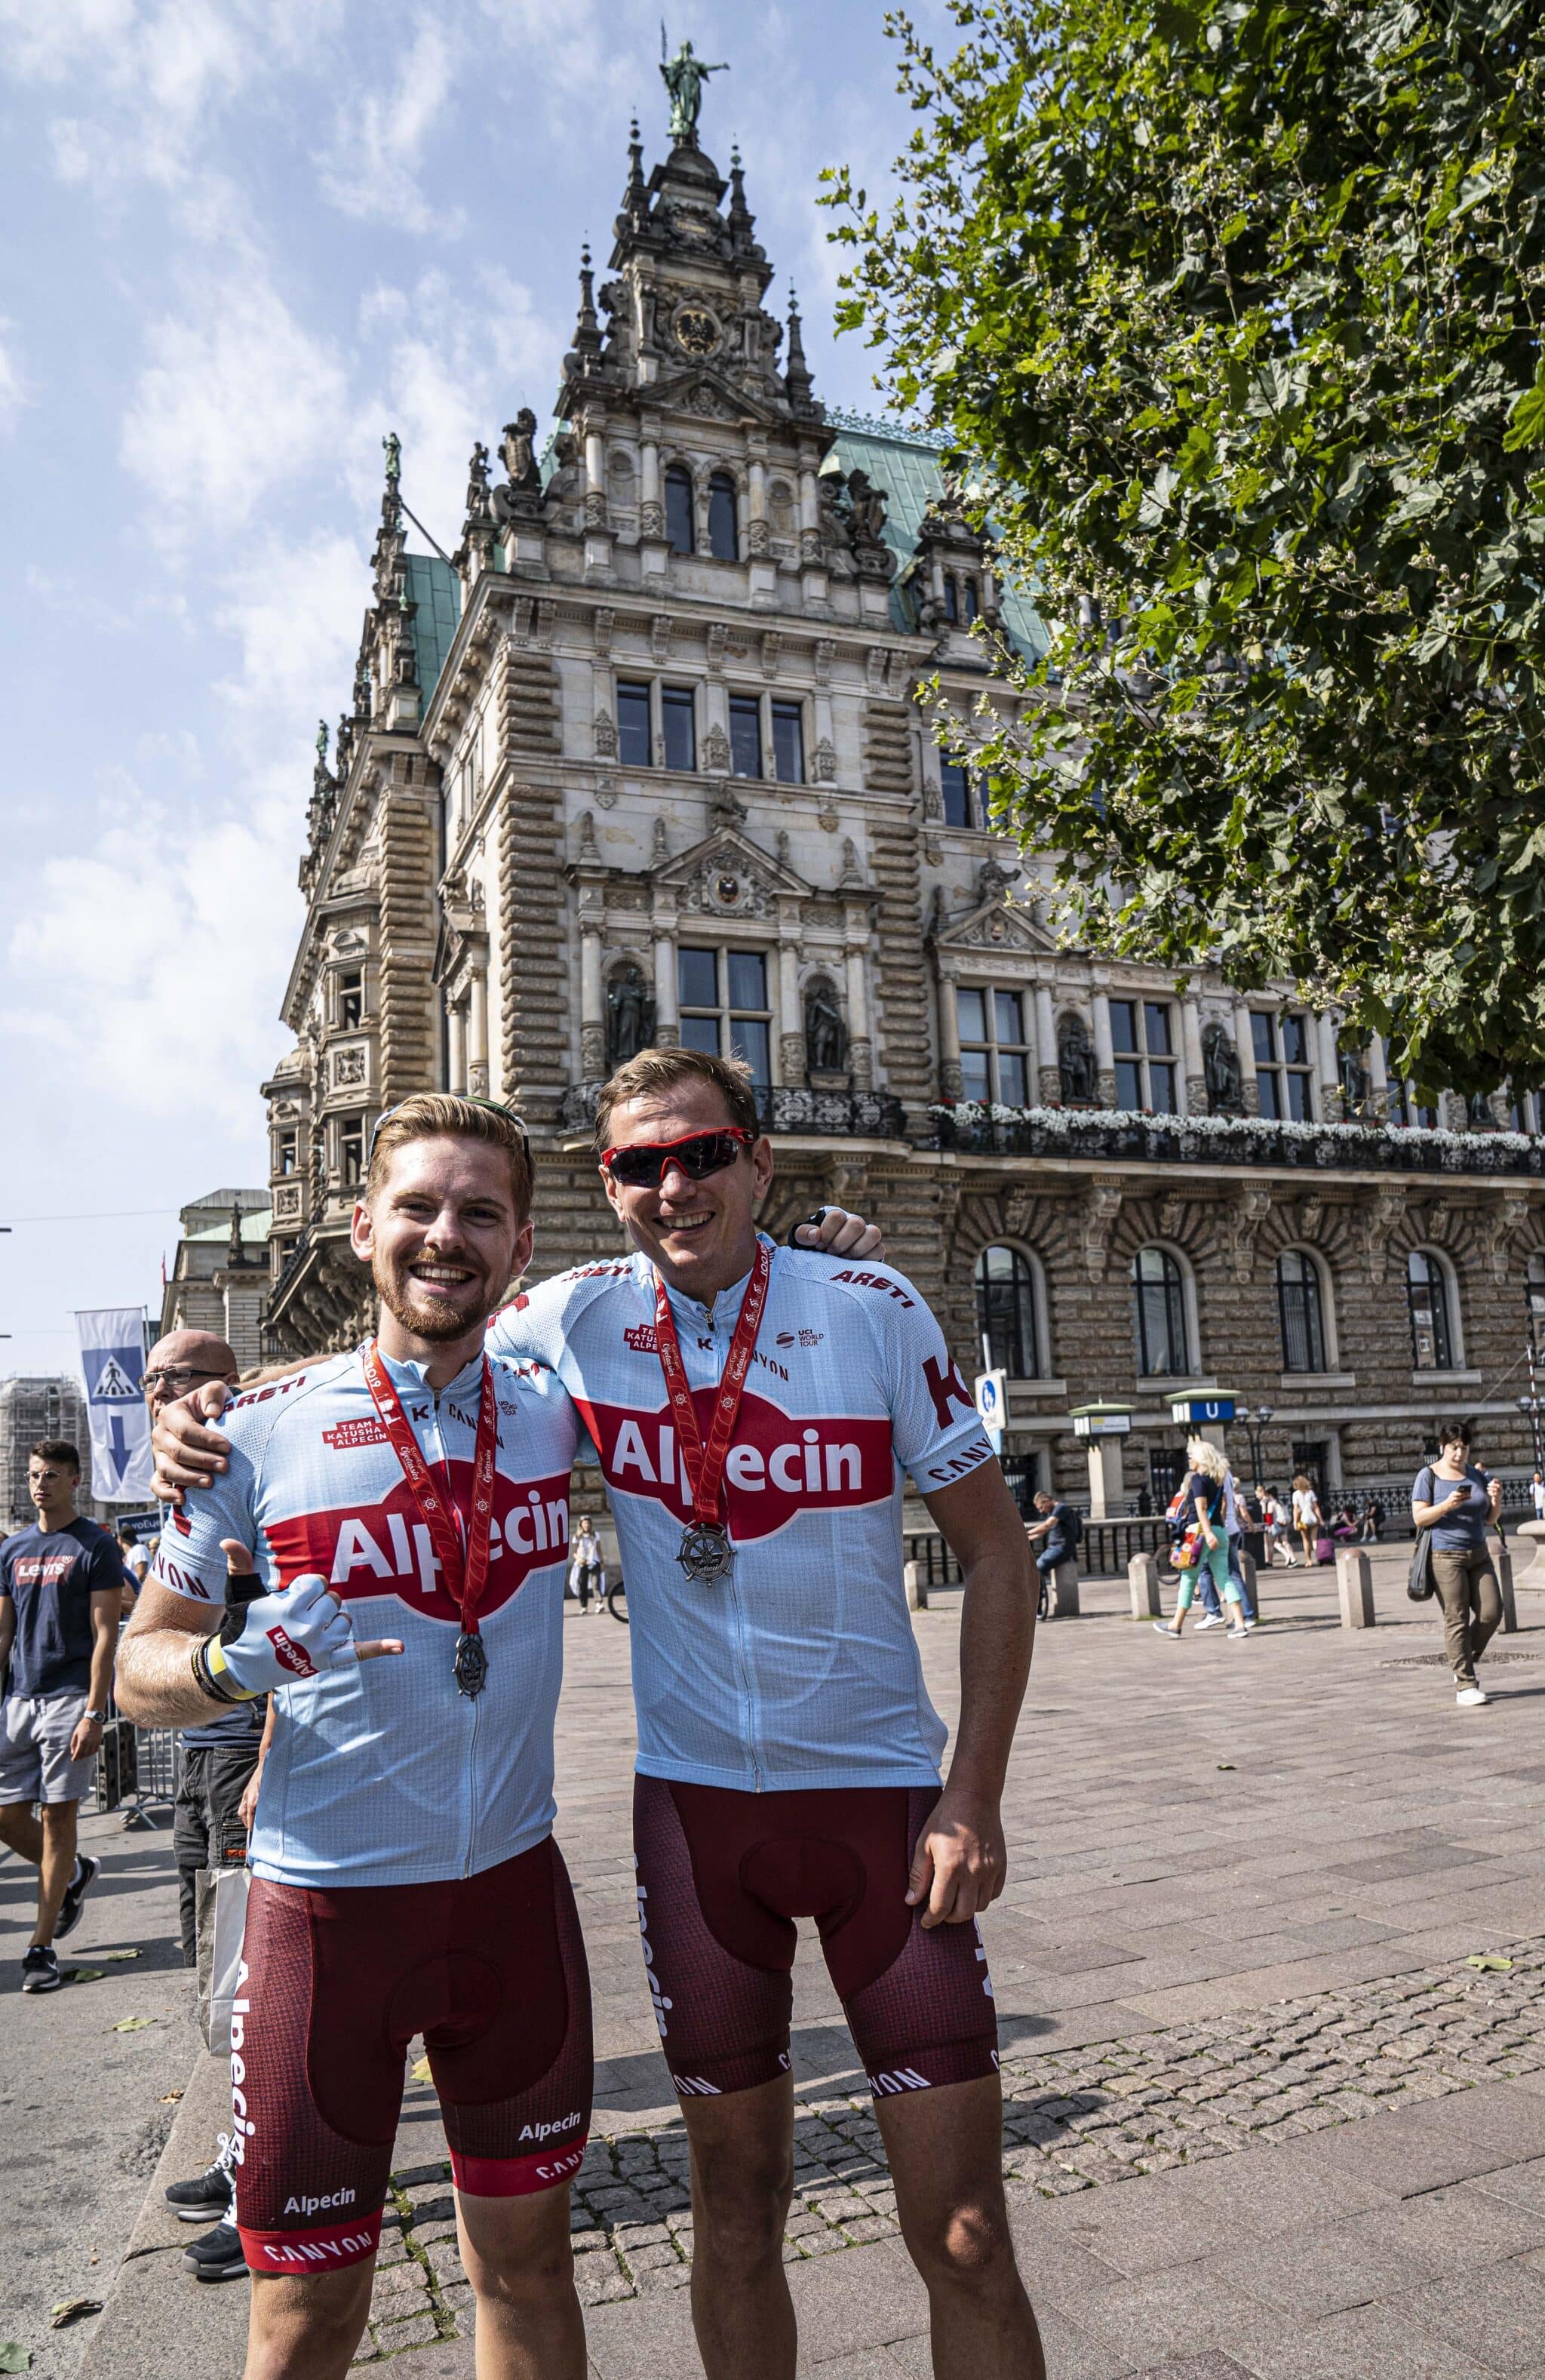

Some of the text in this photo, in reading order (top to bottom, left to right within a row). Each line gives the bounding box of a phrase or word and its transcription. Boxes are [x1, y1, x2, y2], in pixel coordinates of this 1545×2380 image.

[829, 1270, 916, 1309] ARETI
[634, 1341, 658, 1351] ALPE
[751, 1350, 790, 1382] NYON
[1206, 1402, 1218, 1419] U
[327, 1426, 382, 1441] KATUSHA
[337, 1433, 387, 1446] ALPECIN
[341, 1421, 372, 1431] TEAM
[273, 1631, 315, 1675] Alpecin
[518, 2112, 581, 2142] Alpecin
[284, 2187, 355, 2216] Alpecin
[264, 2231, 373, 2261] CANYON
